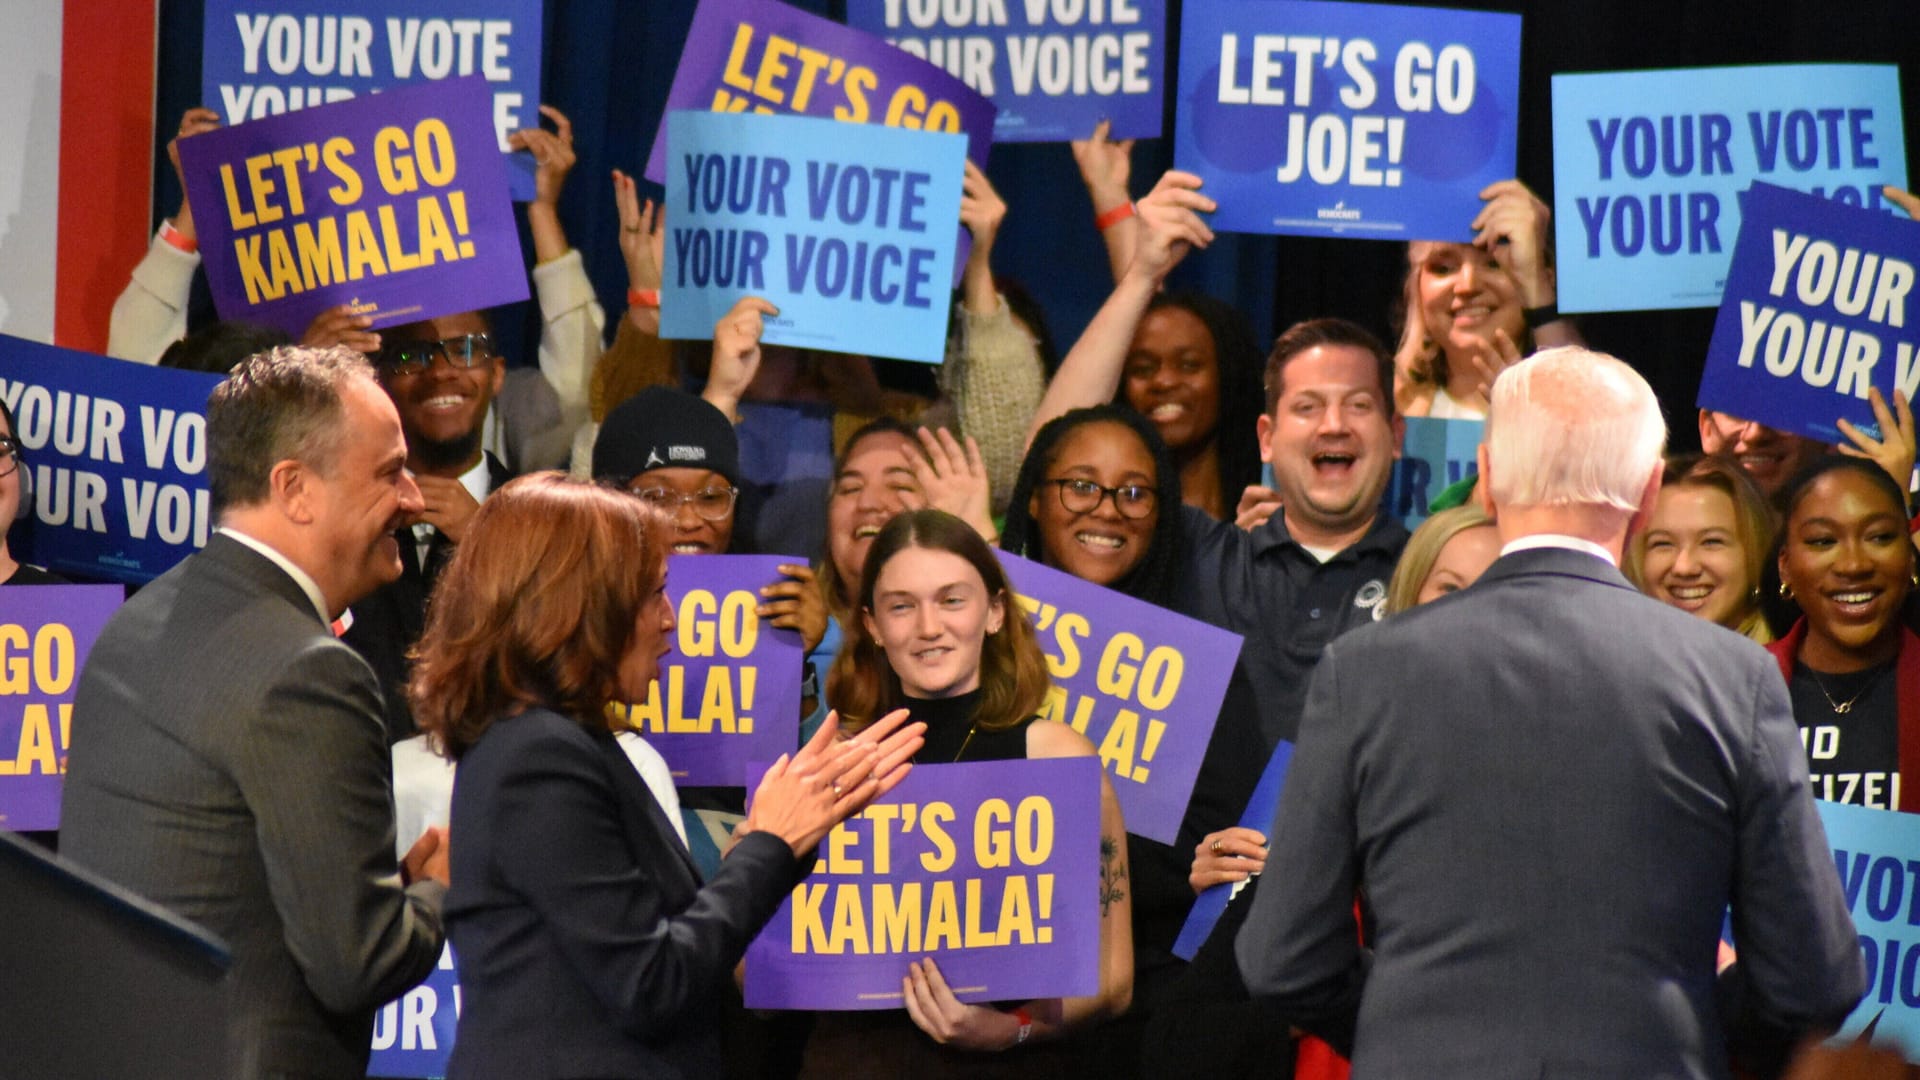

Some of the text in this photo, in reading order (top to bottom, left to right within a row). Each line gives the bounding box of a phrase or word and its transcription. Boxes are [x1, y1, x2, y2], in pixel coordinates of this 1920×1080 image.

[236, 14, 512, 81] YOUR VOTE
[1006, 32, 1150, 95] VOICE
[1218, 33, 1475, 114] LET'S GO
[219, 136, 363, 231] LET'S
[377, 118, 457, 195] GO
[1277, 113, 1405, 187] JOE!
[1587, 108, 1880, 180] YOUR VOTE
[684, 154, 931, 233] YOUR VOTE
[1575, 190, 1723, 258] YOUR
[235, 190, 475, 304] KAMALA!
[674, 229, 936, 309] YOUR VOICE
[1769, 229, 1915, 328] YOUR
[1737, 300, 1881, 400] YOUR
[0, 623, 75, 695] GO
[678, 589, 760, 658] GO
[1096, 632, 1184, 711] GO
[812, 795, 1054, 875] ET'S GO
[791, 873, 1055, 955] KAMALA!
